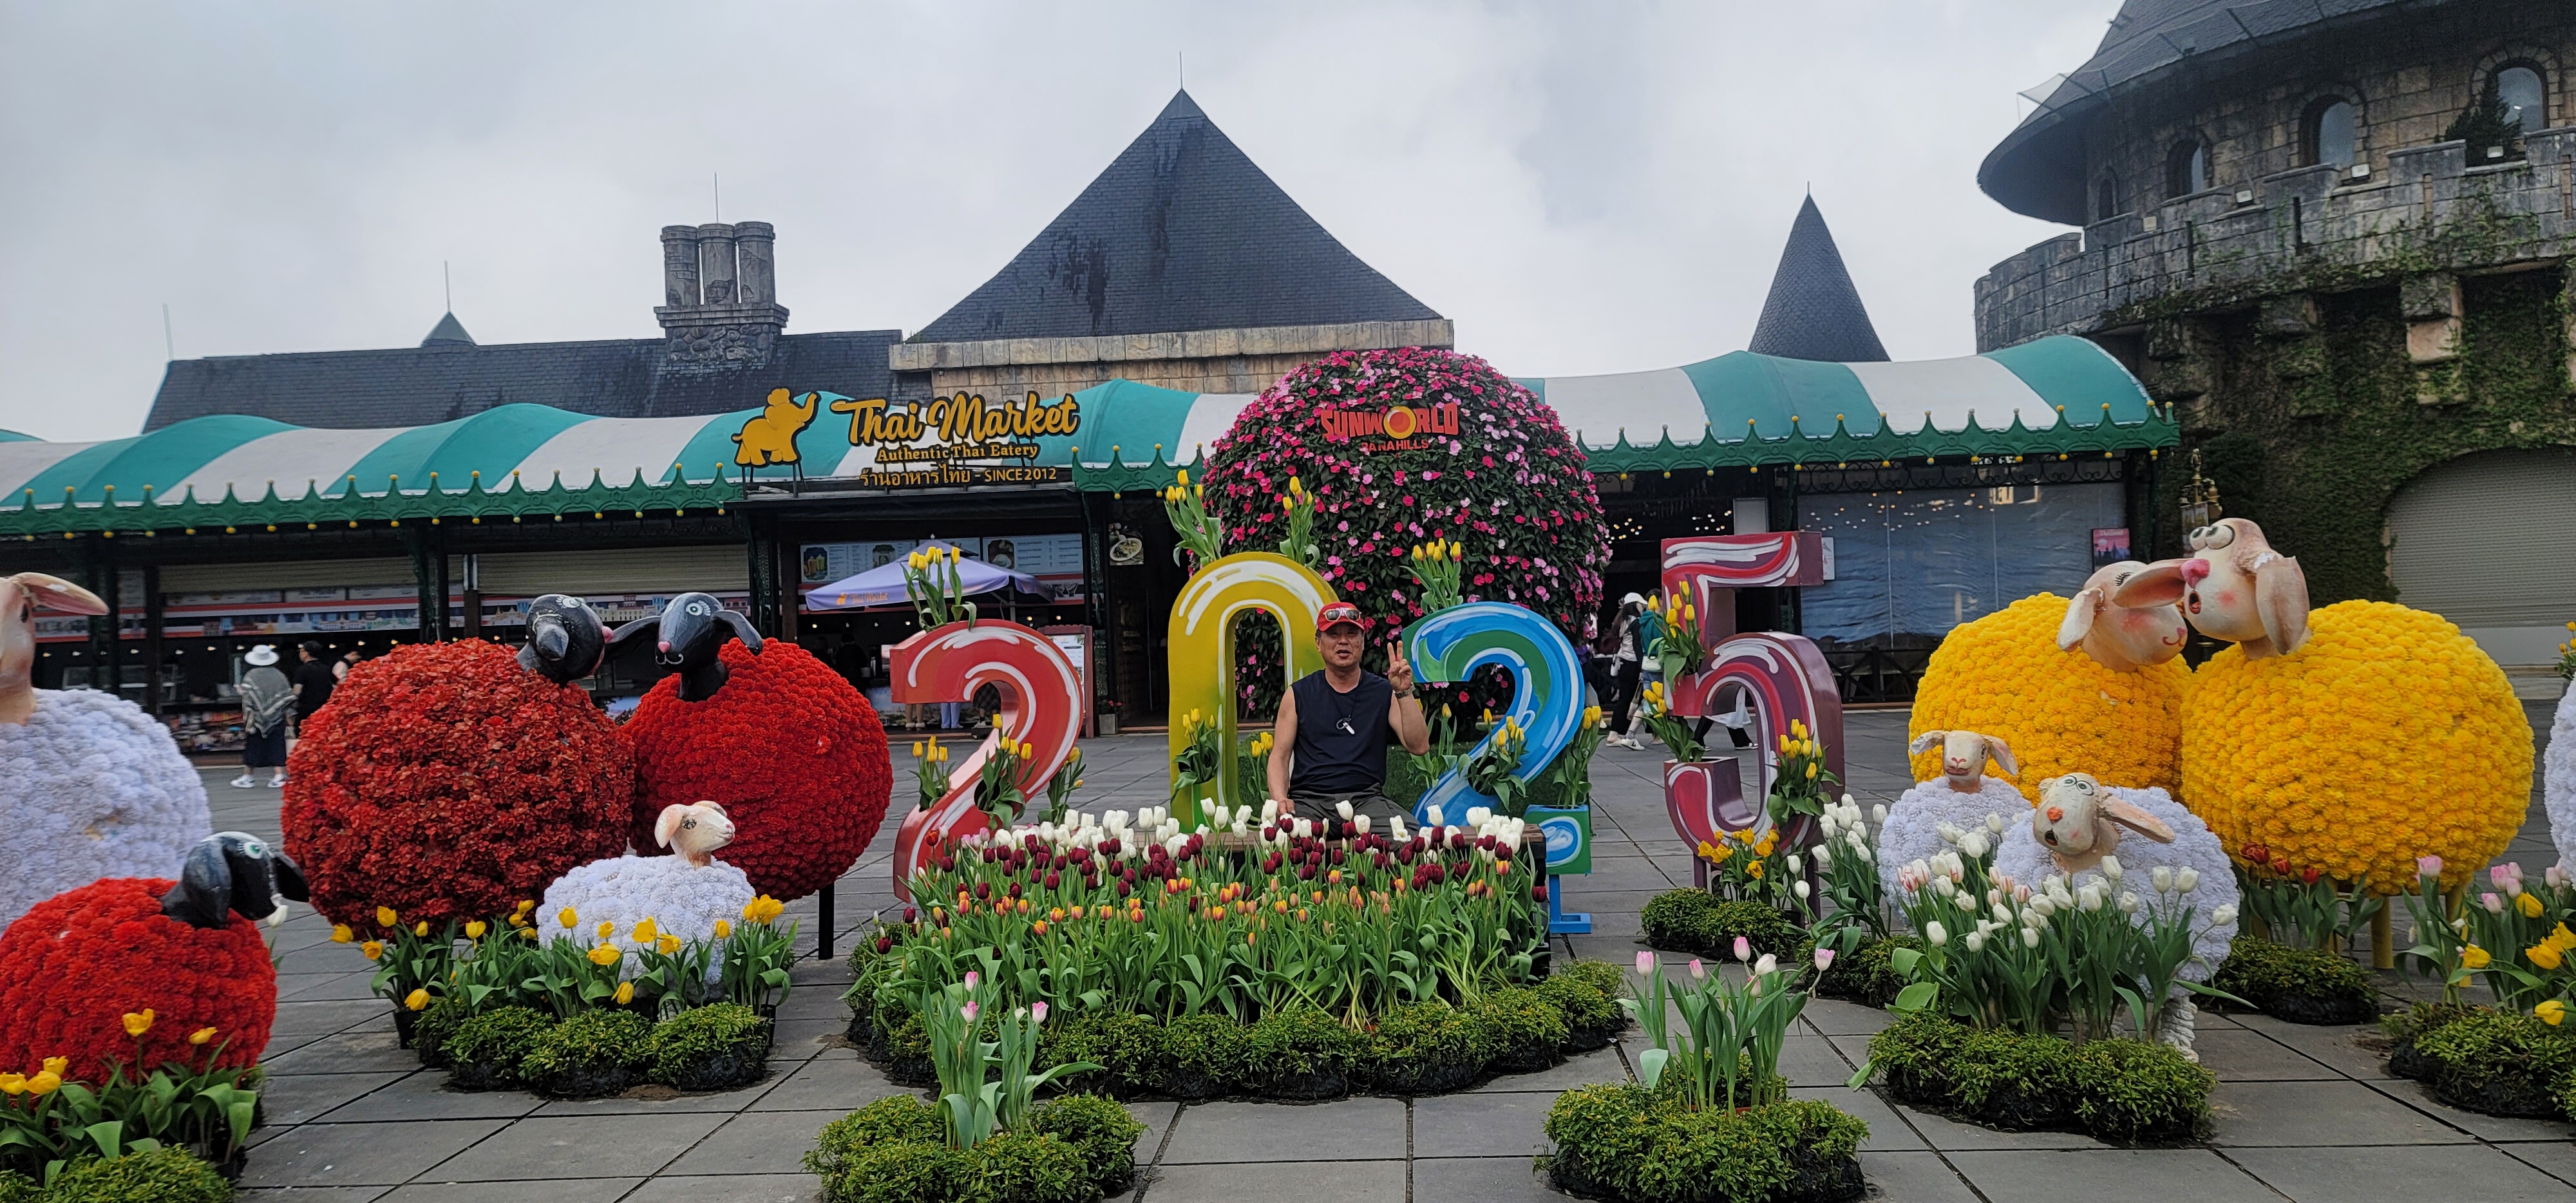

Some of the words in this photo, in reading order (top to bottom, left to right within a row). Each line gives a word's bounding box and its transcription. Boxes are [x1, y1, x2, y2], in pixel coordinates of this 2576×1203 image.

[831, 395, 925, 444] Thai
[927, 392, 1079, 442] Market
[1396, 439, 1429, 451] HILLS
[876, 448, 949, 462] Authentic
[951, 446, 986, 459] Thai
[989, 445, 1039, 460] Eatery
[985, 469, 1023, 483] SINCE
[1025, 468, 1057, 482] 2012
